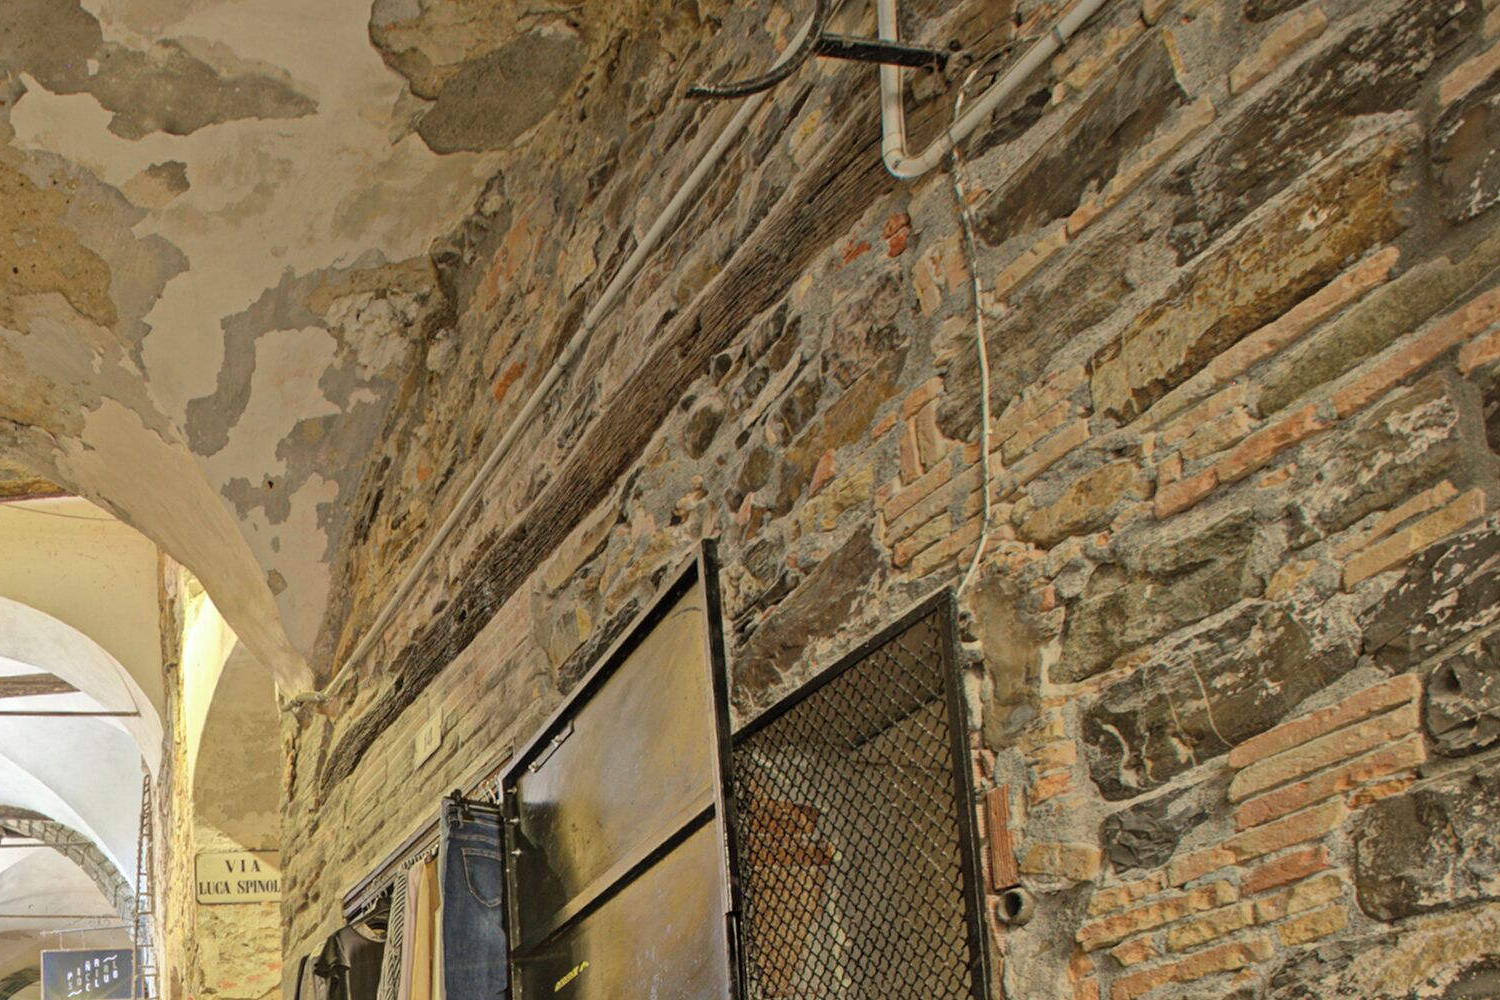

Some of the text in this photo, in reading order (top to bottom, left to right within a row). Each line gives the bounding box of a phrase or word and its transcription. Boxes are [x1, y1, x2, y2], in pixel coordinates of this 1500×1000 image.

[225, 859, 261, 873] VIA
[198, 879, 281, 896] LUCA SPINOL
[85, 970, 118, 992] CLUB
